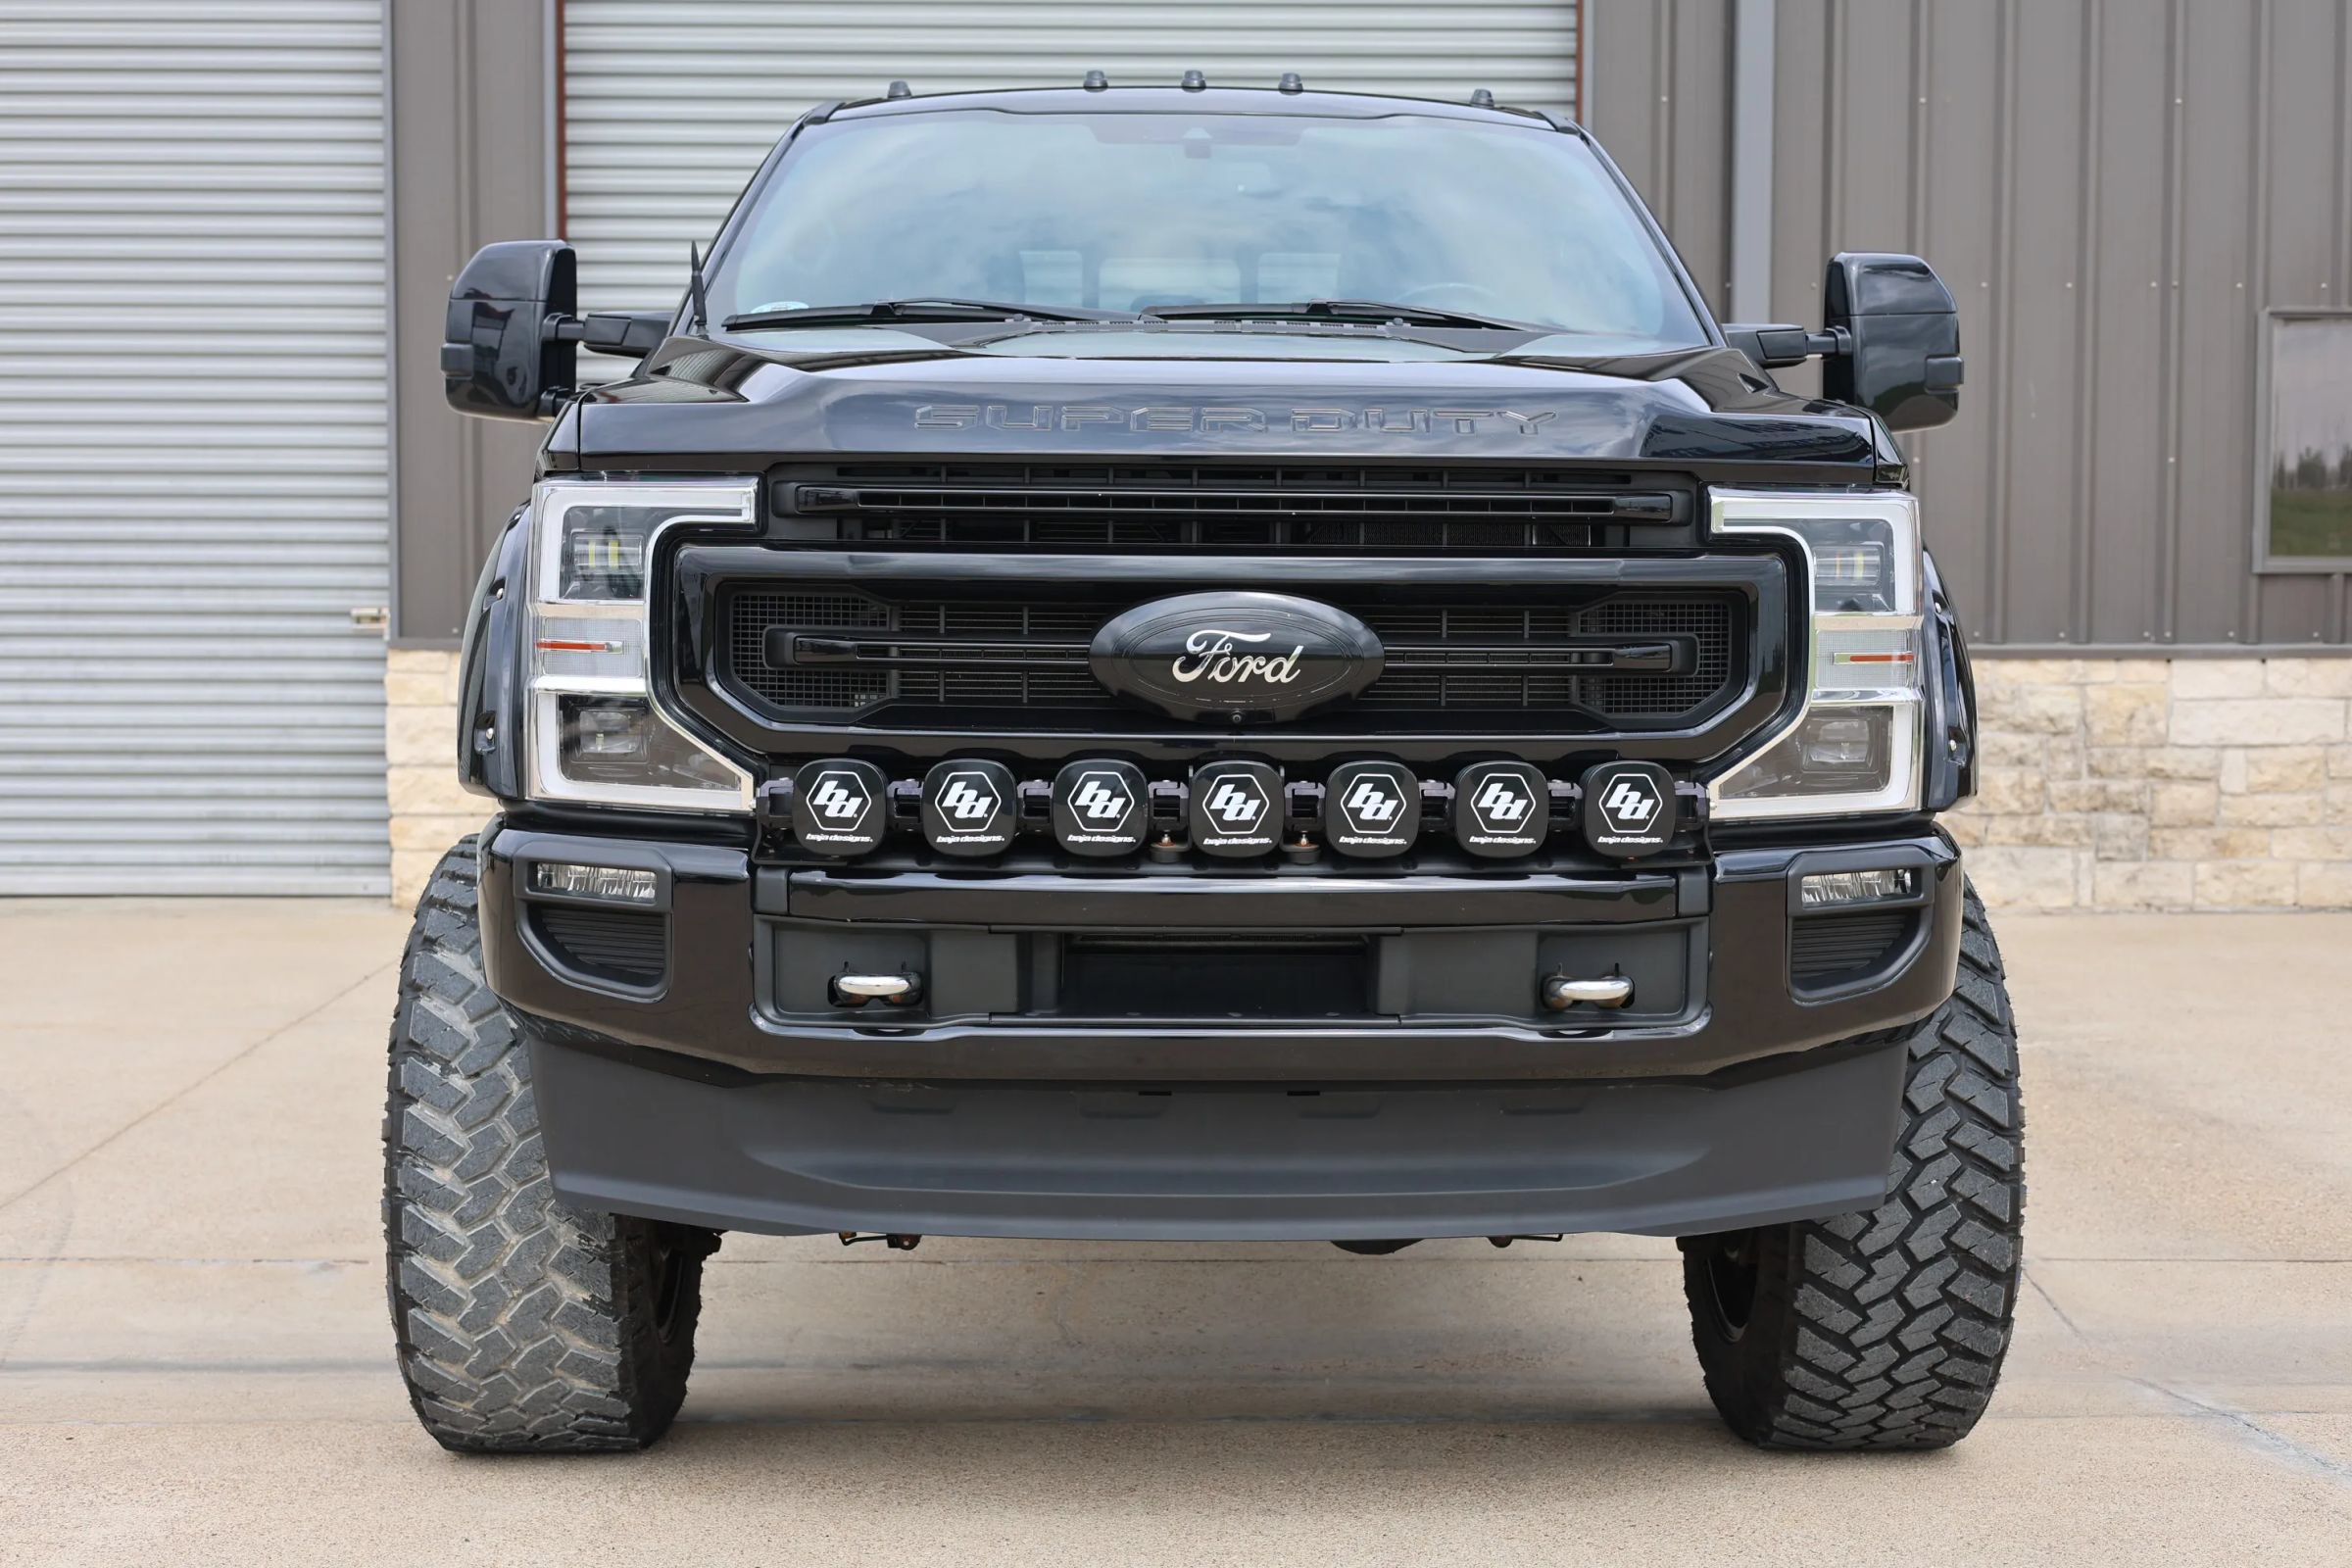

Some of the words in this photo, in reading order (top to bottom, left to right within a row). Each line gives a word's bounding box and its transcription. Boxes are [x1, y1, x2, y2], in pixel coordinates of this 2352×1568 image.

[914, 405, 1267, 432] SUPER
[1290, 407, 1558, 434] DUTY
[1172, 629, 1304, 683] Ford
